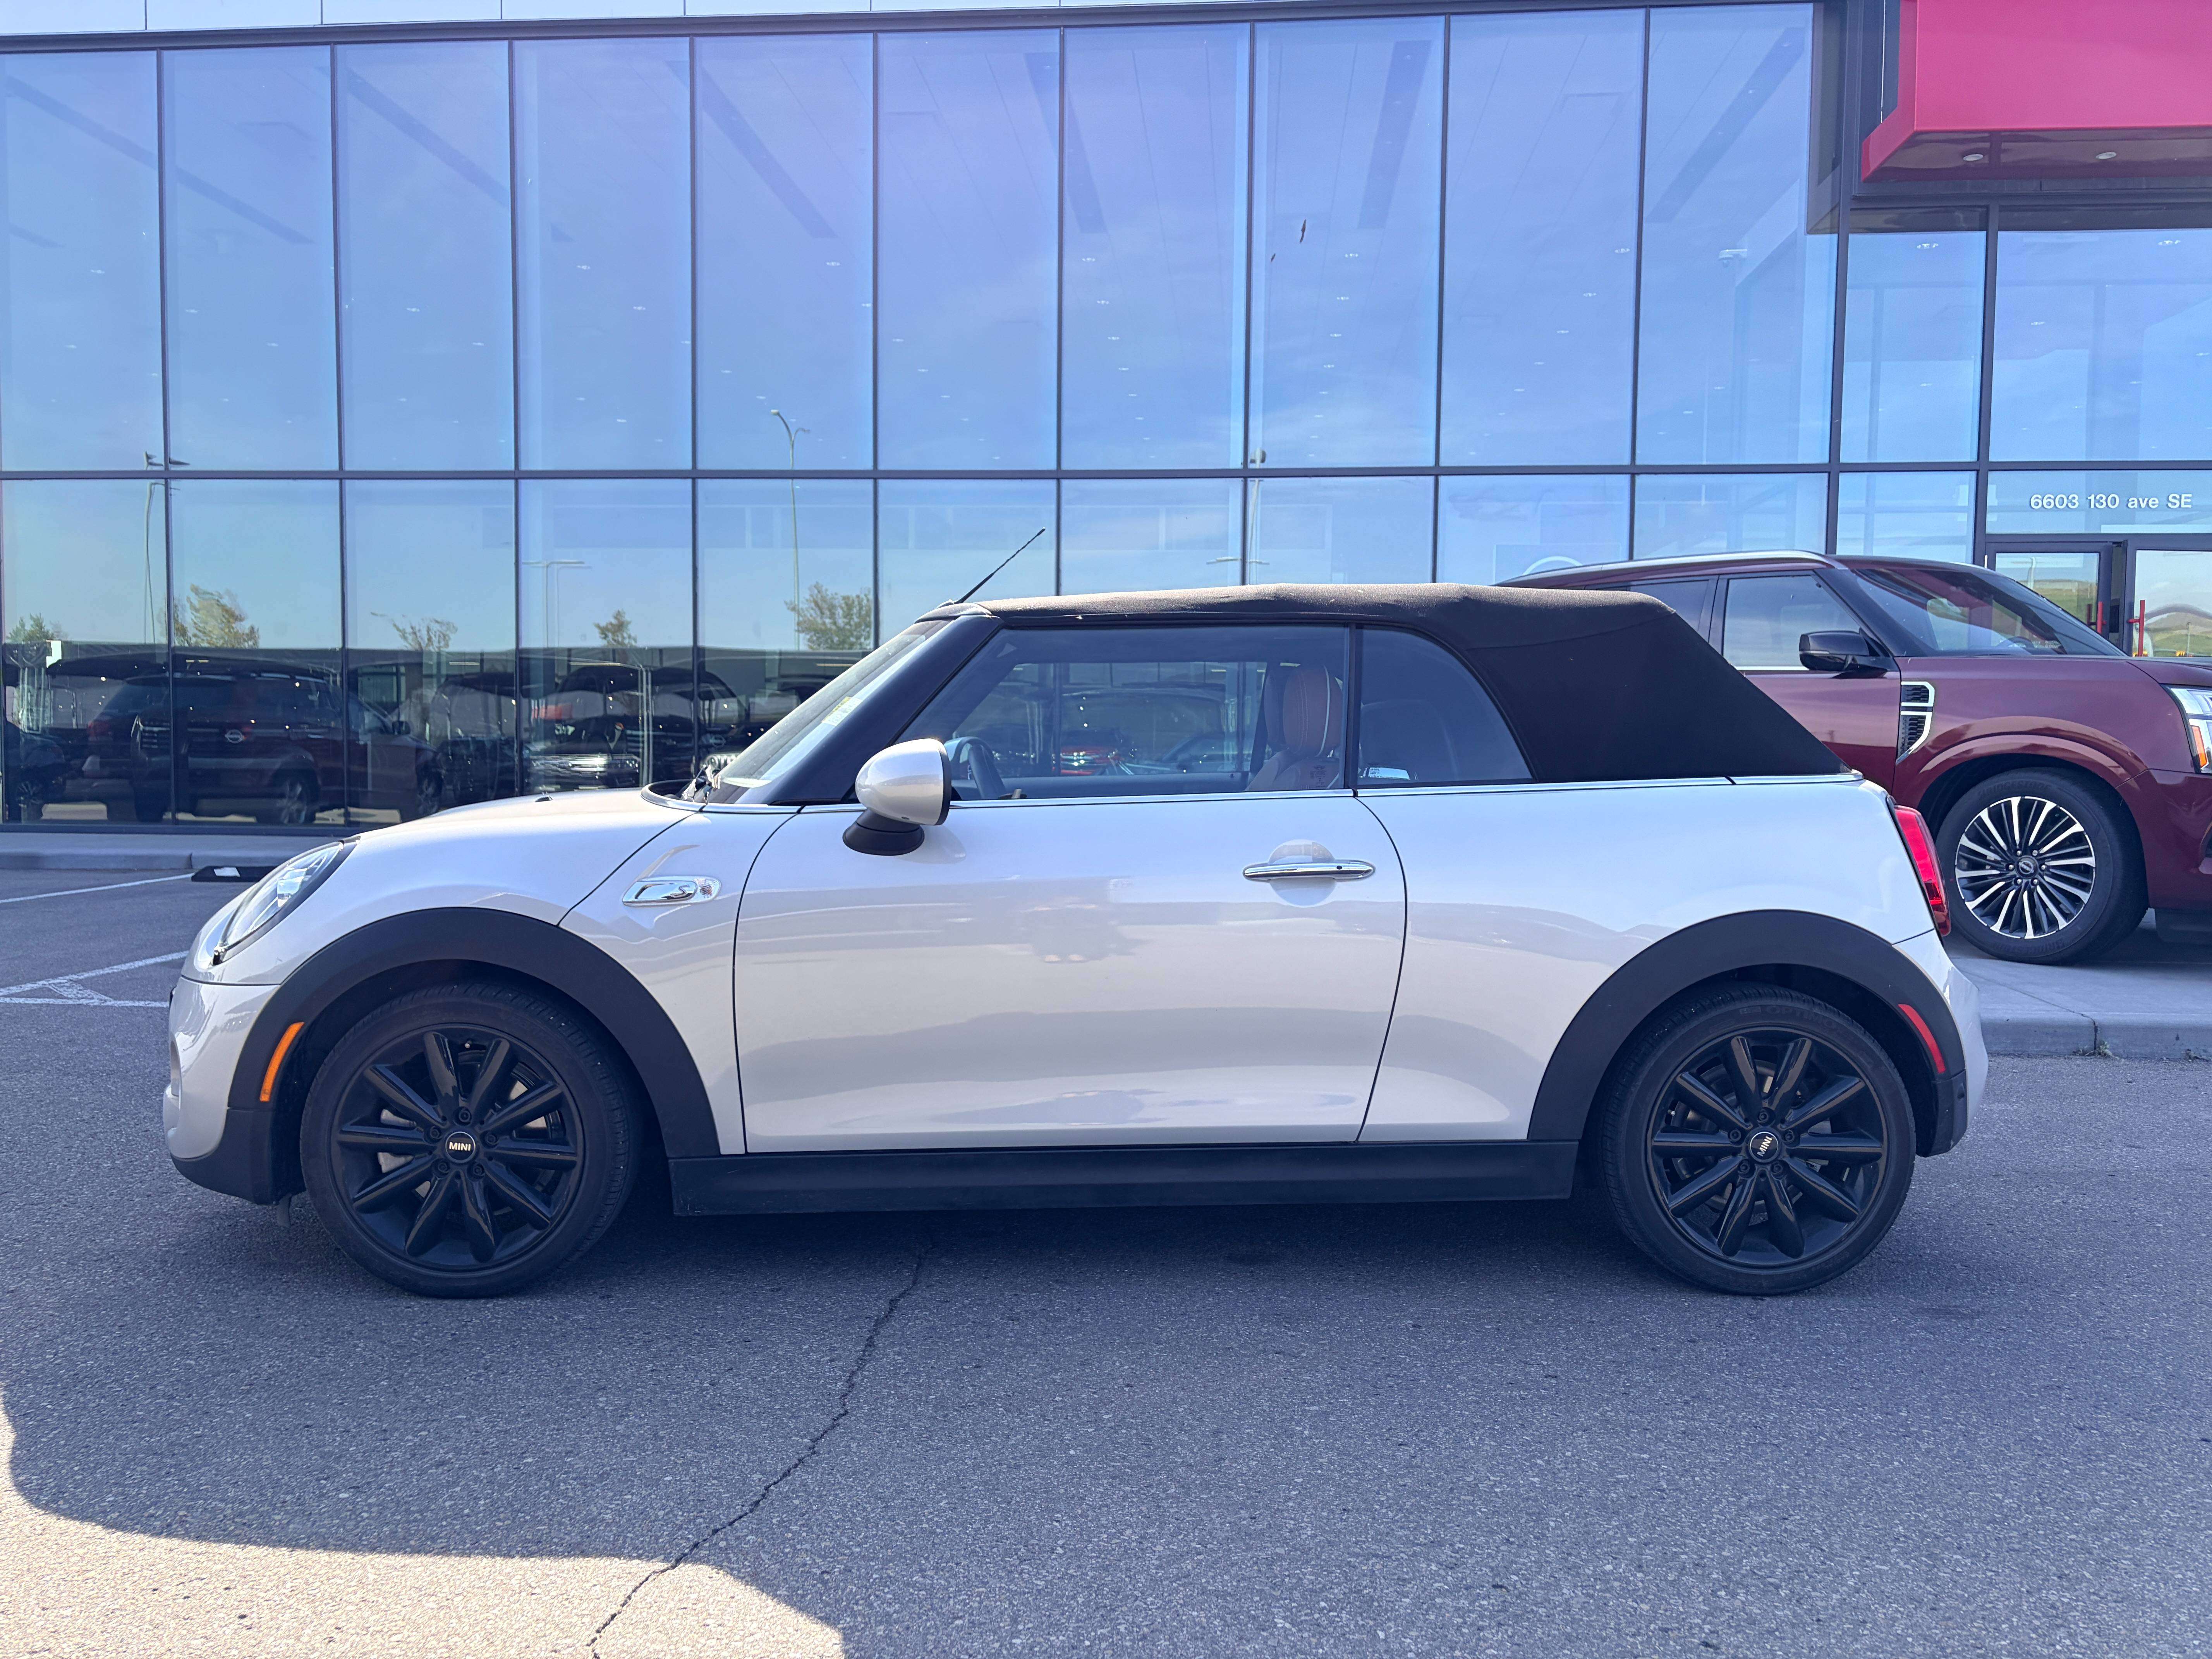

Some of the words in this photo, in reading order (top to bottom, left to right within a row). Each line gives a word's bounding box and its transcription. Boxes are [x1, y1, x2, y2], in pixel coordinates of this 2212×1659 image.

[2030, 494, 2079, 509] 6603
[2088, 494, 2119, 508] 130
[2128, 497, 2159, 508] ave
[2167, 494, 2192, 508] SE
[449, 1142, 471, 1151] MINI
[1757, 1136, 1772, 1157] MINI
